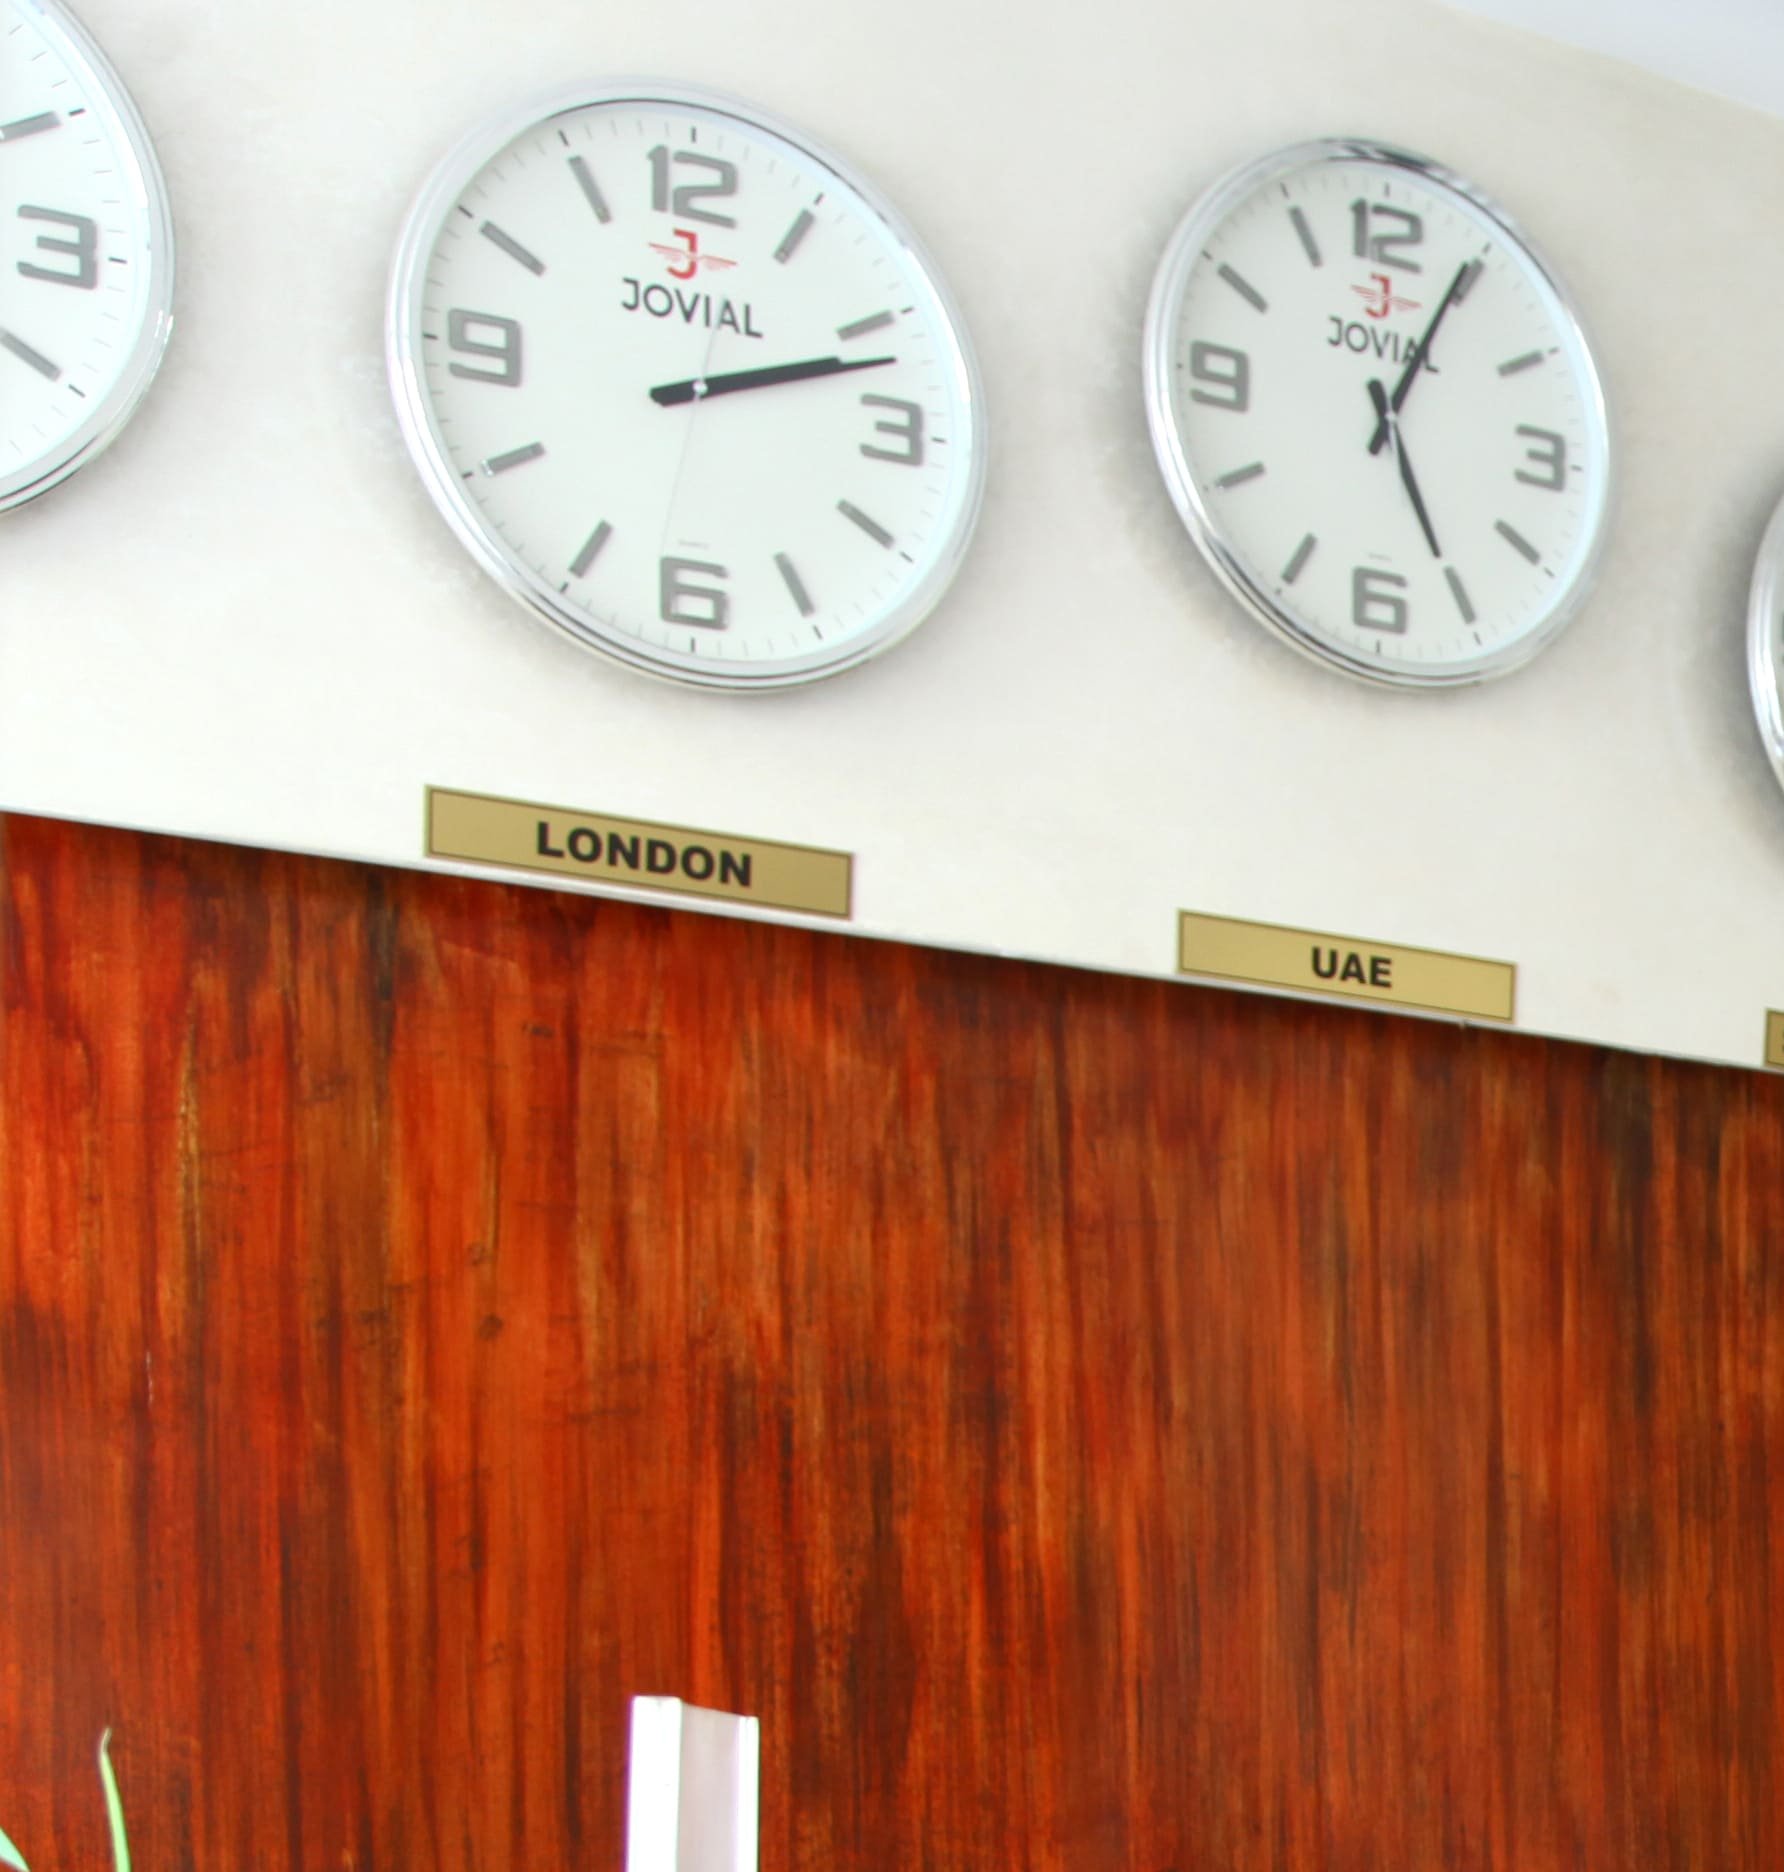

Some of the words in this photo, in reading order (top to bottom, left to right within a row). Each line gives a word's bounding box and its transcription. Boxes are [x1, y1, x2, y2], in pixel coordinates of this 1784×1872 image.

[648, 145, 737, 228] 12
[17, 205, 98, 290] 3
[1351, 199, 1422, 272] 12
[622, 277, 763, 338] JOVIAL
[449, 309, 520, 386] 9
[1191, 342, 1248, 411] 9
[1328, 316, 1439, 373] JOVIAL
[861, 394, 922, 466] 3
[1515, 426, 1565, 491] 3
[661, 558, 726, 629] 6
[1354, 568, 1406, 633] 6
[536, 821, 752, 887] LONDON
[1311, 946, 1392, 988] UAE
